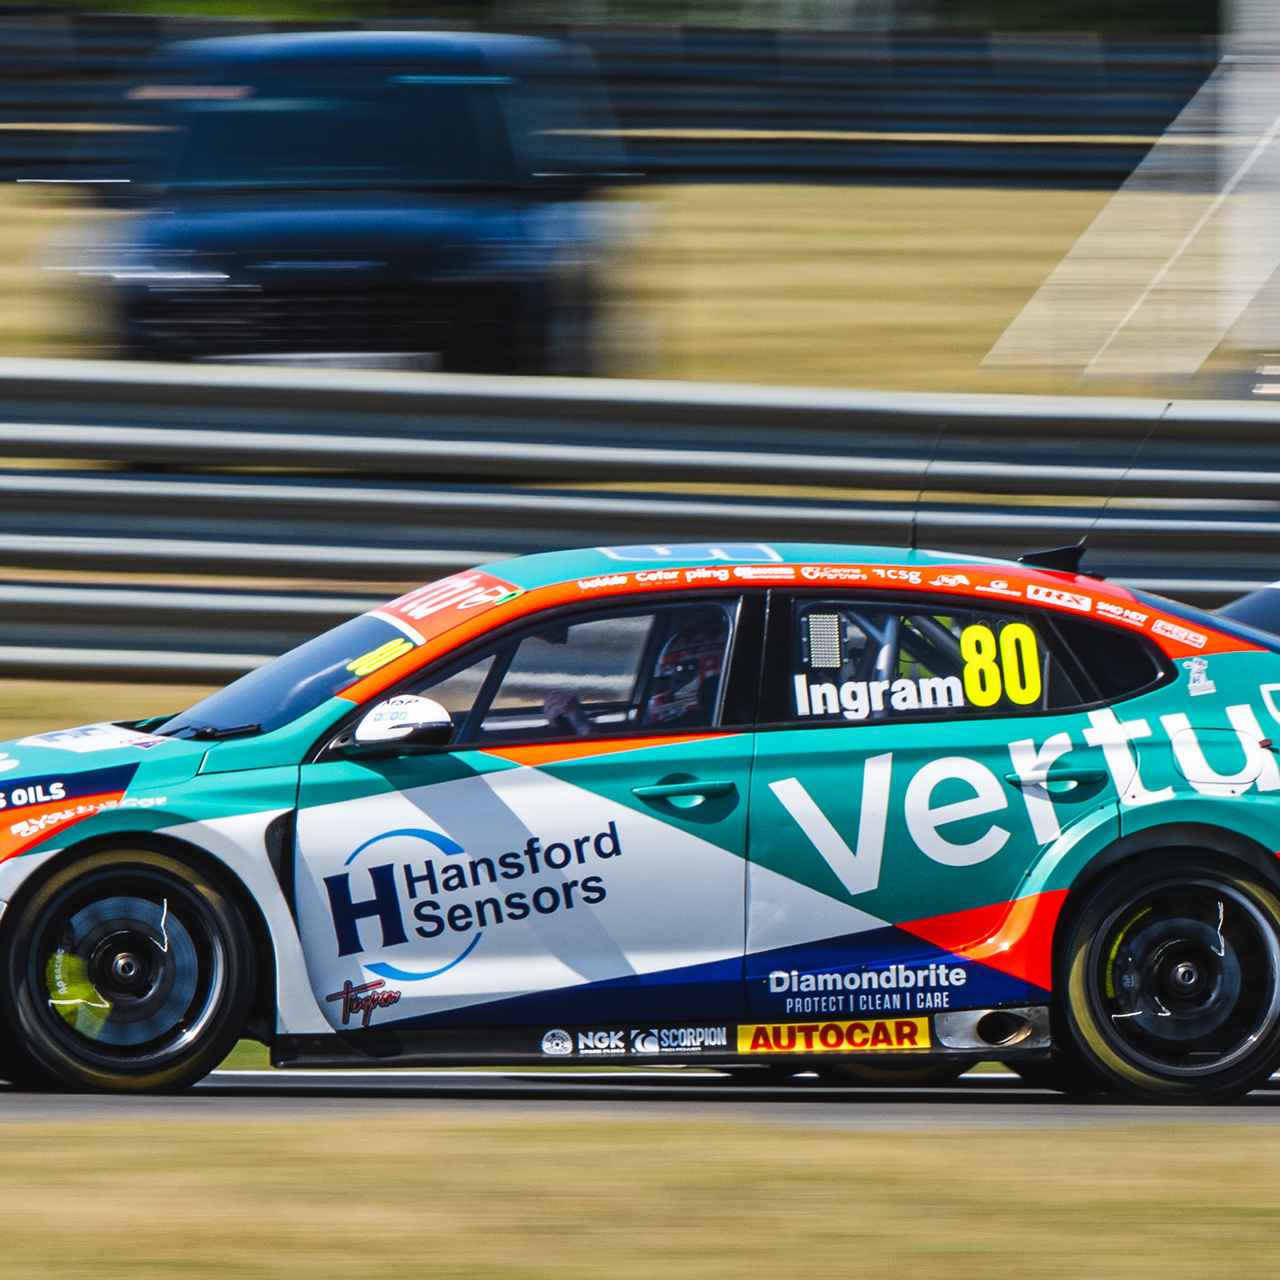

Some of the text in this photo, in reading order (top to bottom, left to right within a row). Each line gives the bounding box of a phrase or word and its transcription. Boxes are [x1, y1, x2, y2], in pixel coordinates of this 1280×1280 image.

[886, 570, 922, 584] csg
[959, 622, 1042, 707] 80
[793, 673, 965, 719] Ingram
[11, 782, 66, 806] OILS
[403, 821, 622, 899] Hansford
[322, 863, 410, 958] H
[413, 875, 607, 938] Sensors
[769, 963, 967, 993] Diamondbrite
[786, 992, 950, 1013] PROTECT CLEAN CARE
[577, 1030, 625, 1049] NGK
[660, 1027, 727, 1047] SCORPION
[750, 1020, 918, 1051] AUTOCAR
